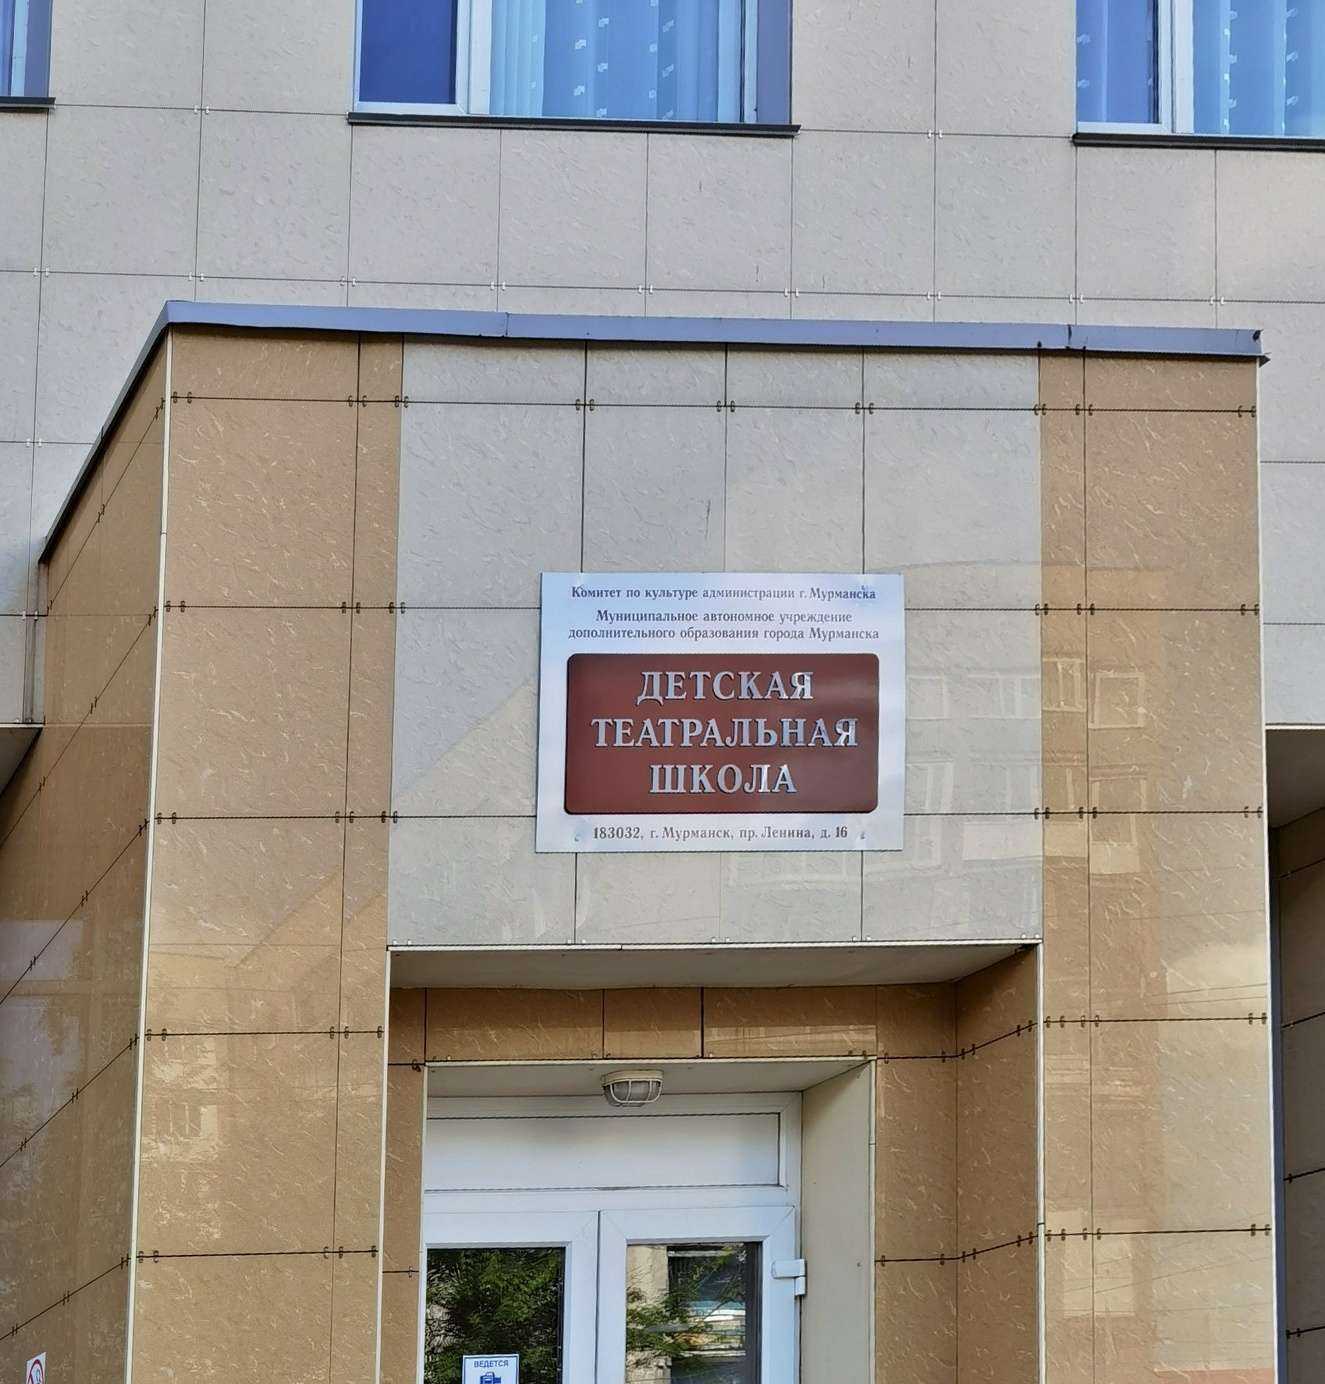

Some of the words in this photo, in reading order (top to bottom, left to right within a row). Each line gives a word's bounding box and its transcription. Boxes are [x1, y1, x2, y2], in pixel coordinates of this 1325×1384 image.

[571, 586, 621, 598] Комитет
[626, 588, 641, 598] по
[645, 588, 698, 600] культуре
[702, 588, 795, 600] администрации
[799, 589, 807, 598] г.
[810, 587, 876, 601] Мурманска
[596, 610, 698, 624] Муниципальное
[703, 612, 775, 622] автономное
[779, 612, 852, 625] учреждение
[568, 627, 676, 640] дополнительного
[680, 626, 759, 641] образования
[764, 629, 804, 641] города
[809, 627, 880, 642] Мурманска
[636, 670, 815, 706] ДЕТСКАЯ
[590, 718, 859, 748] ТЕАТРАЛЬНАЯ
[648, 764, 799, 795] ШКОЛА
[593, 826, 644, 840] 183032,
[650, 829, 659, 839] г.
[662, 826, 734, 841] Мурманск,
[739, 829, 758, 841] пр.
[761, 826, 815, 840] Ленина,
[819, 829, 832, 840] д.
[835, 826, 848, 839] 16
[473, 1359, 509, 1368] ВЕДЕТСЯ
